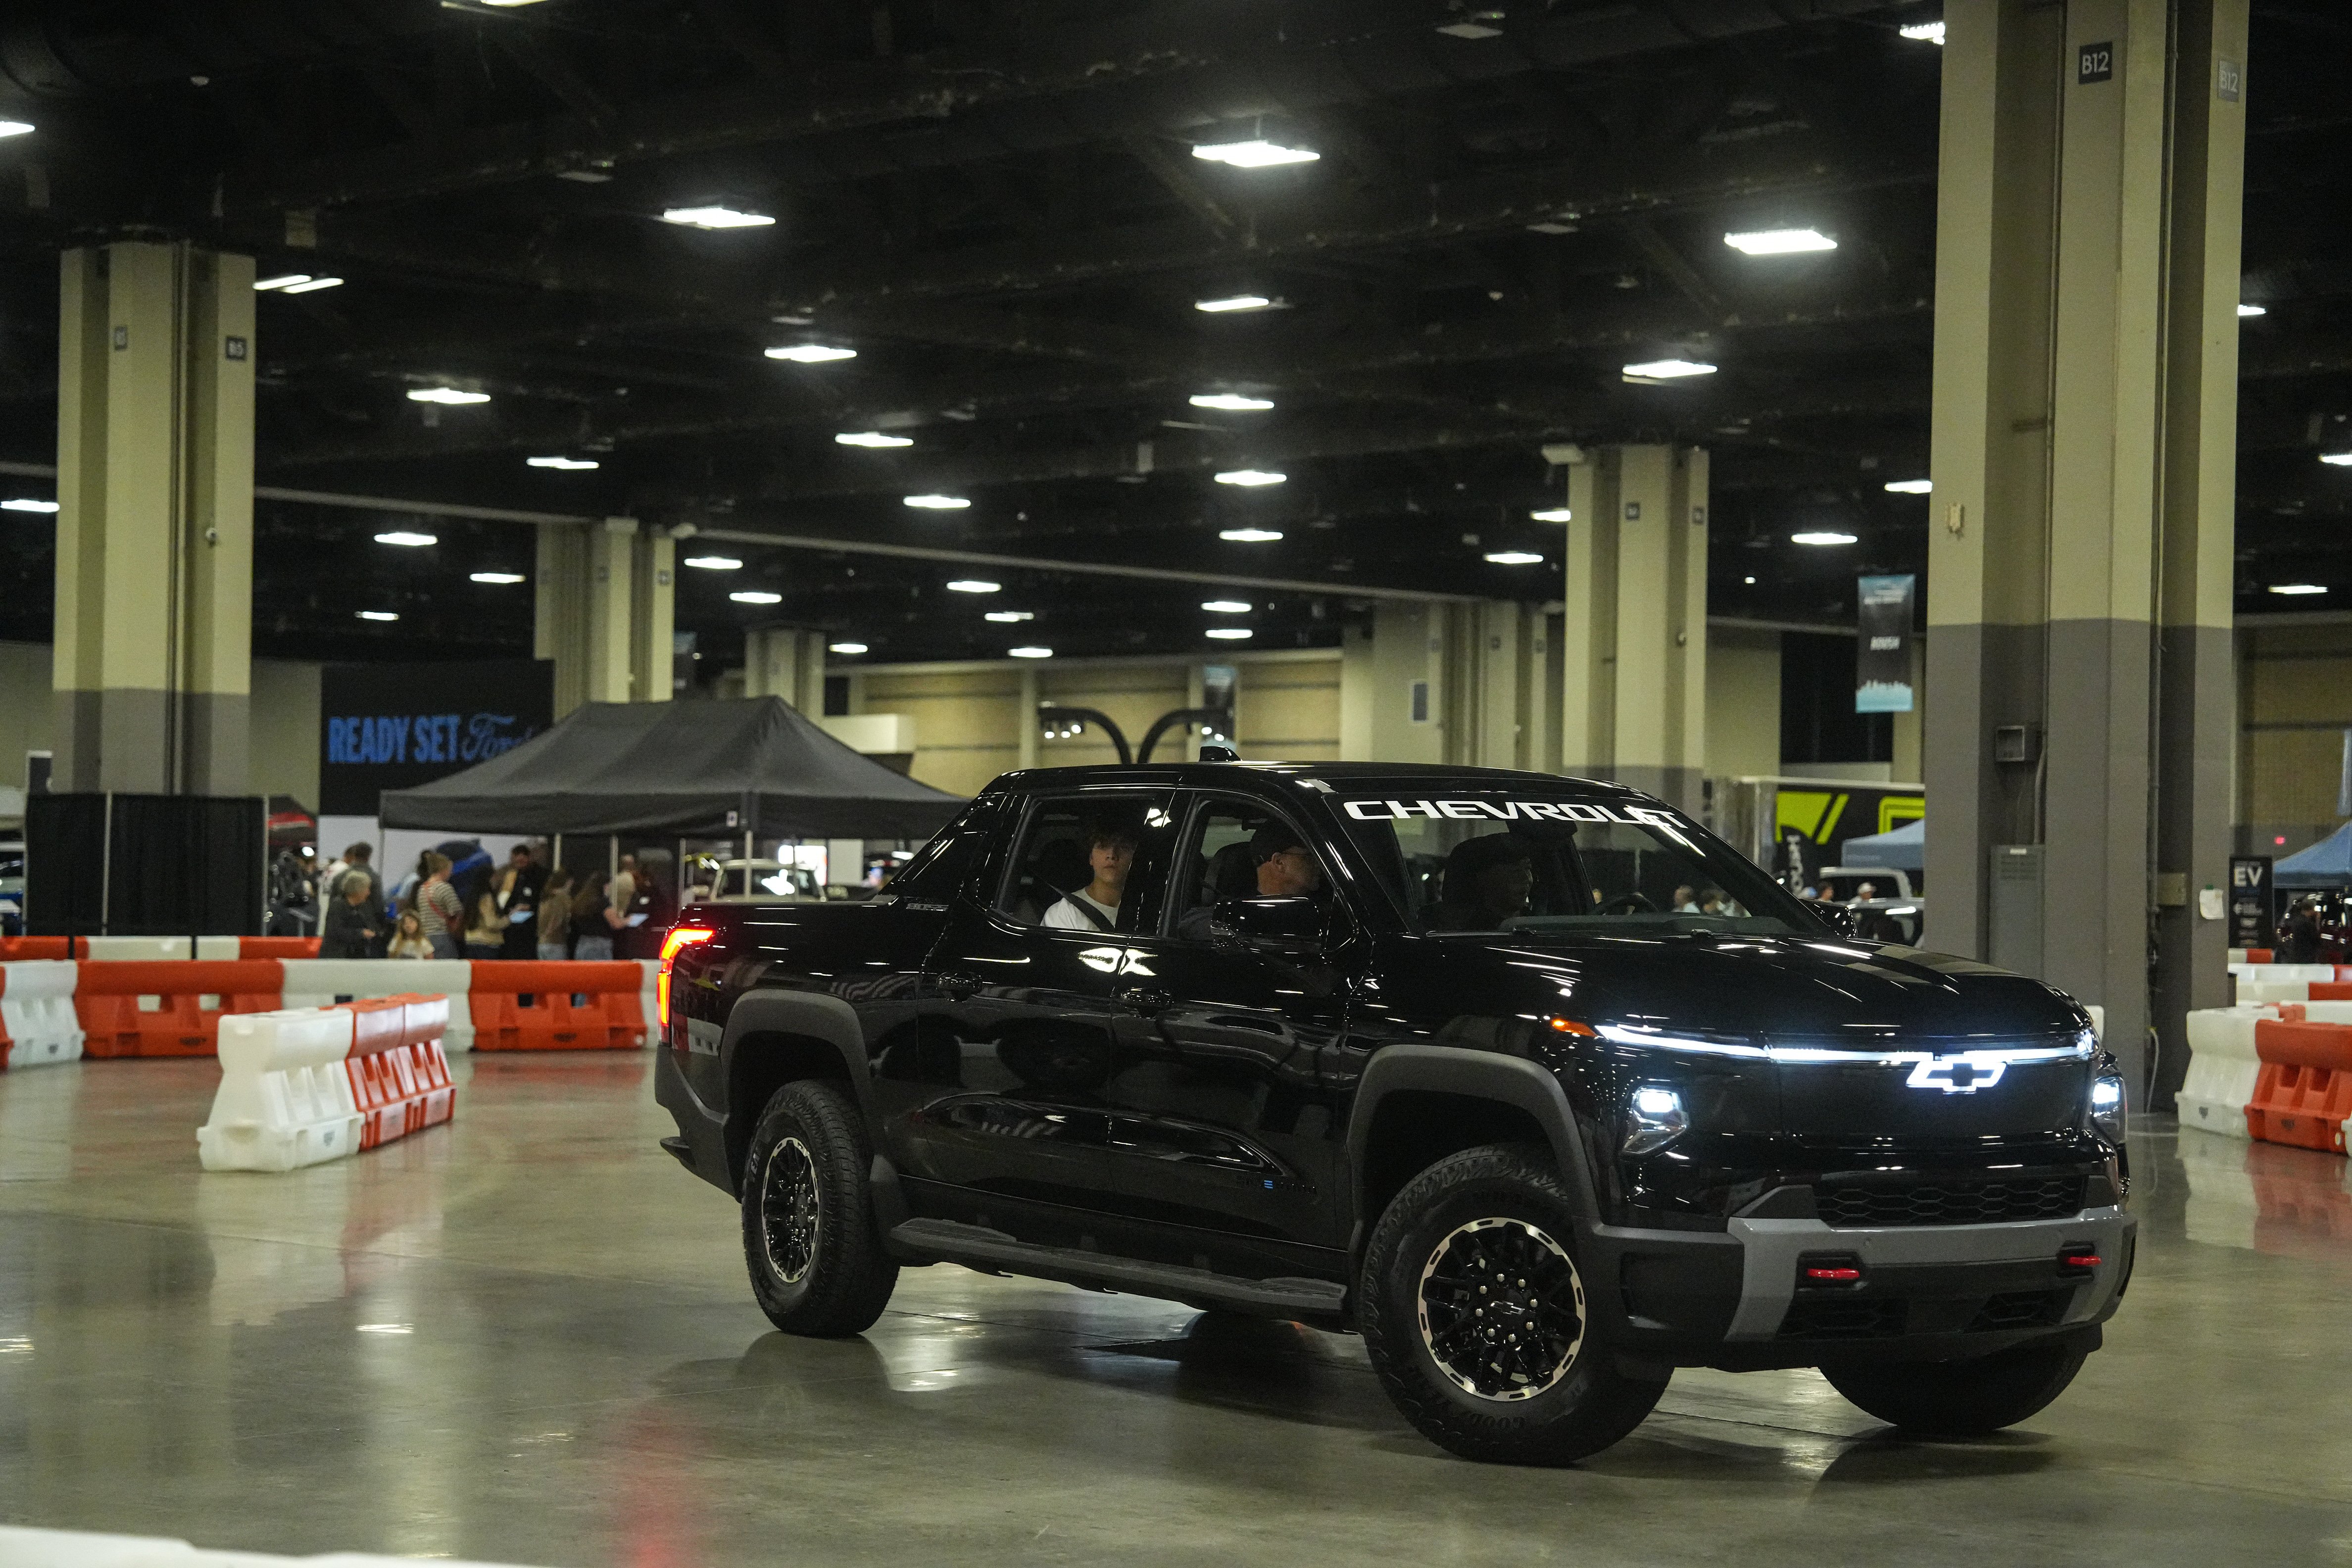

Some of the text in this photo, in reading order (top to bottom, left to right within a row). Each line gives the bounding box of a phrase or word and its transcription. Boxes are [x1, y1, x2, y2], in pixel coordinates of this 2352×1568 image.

[2082, 51, 2108, 74] B12
[2220, 71, 2238, 93] B12
[329, 717, 410, 763] READY
[414, 715, 460, 763] SET
[1343, 800, 1688, 829] CHEVROLET
[2234, 866, 2262, 887] EV
